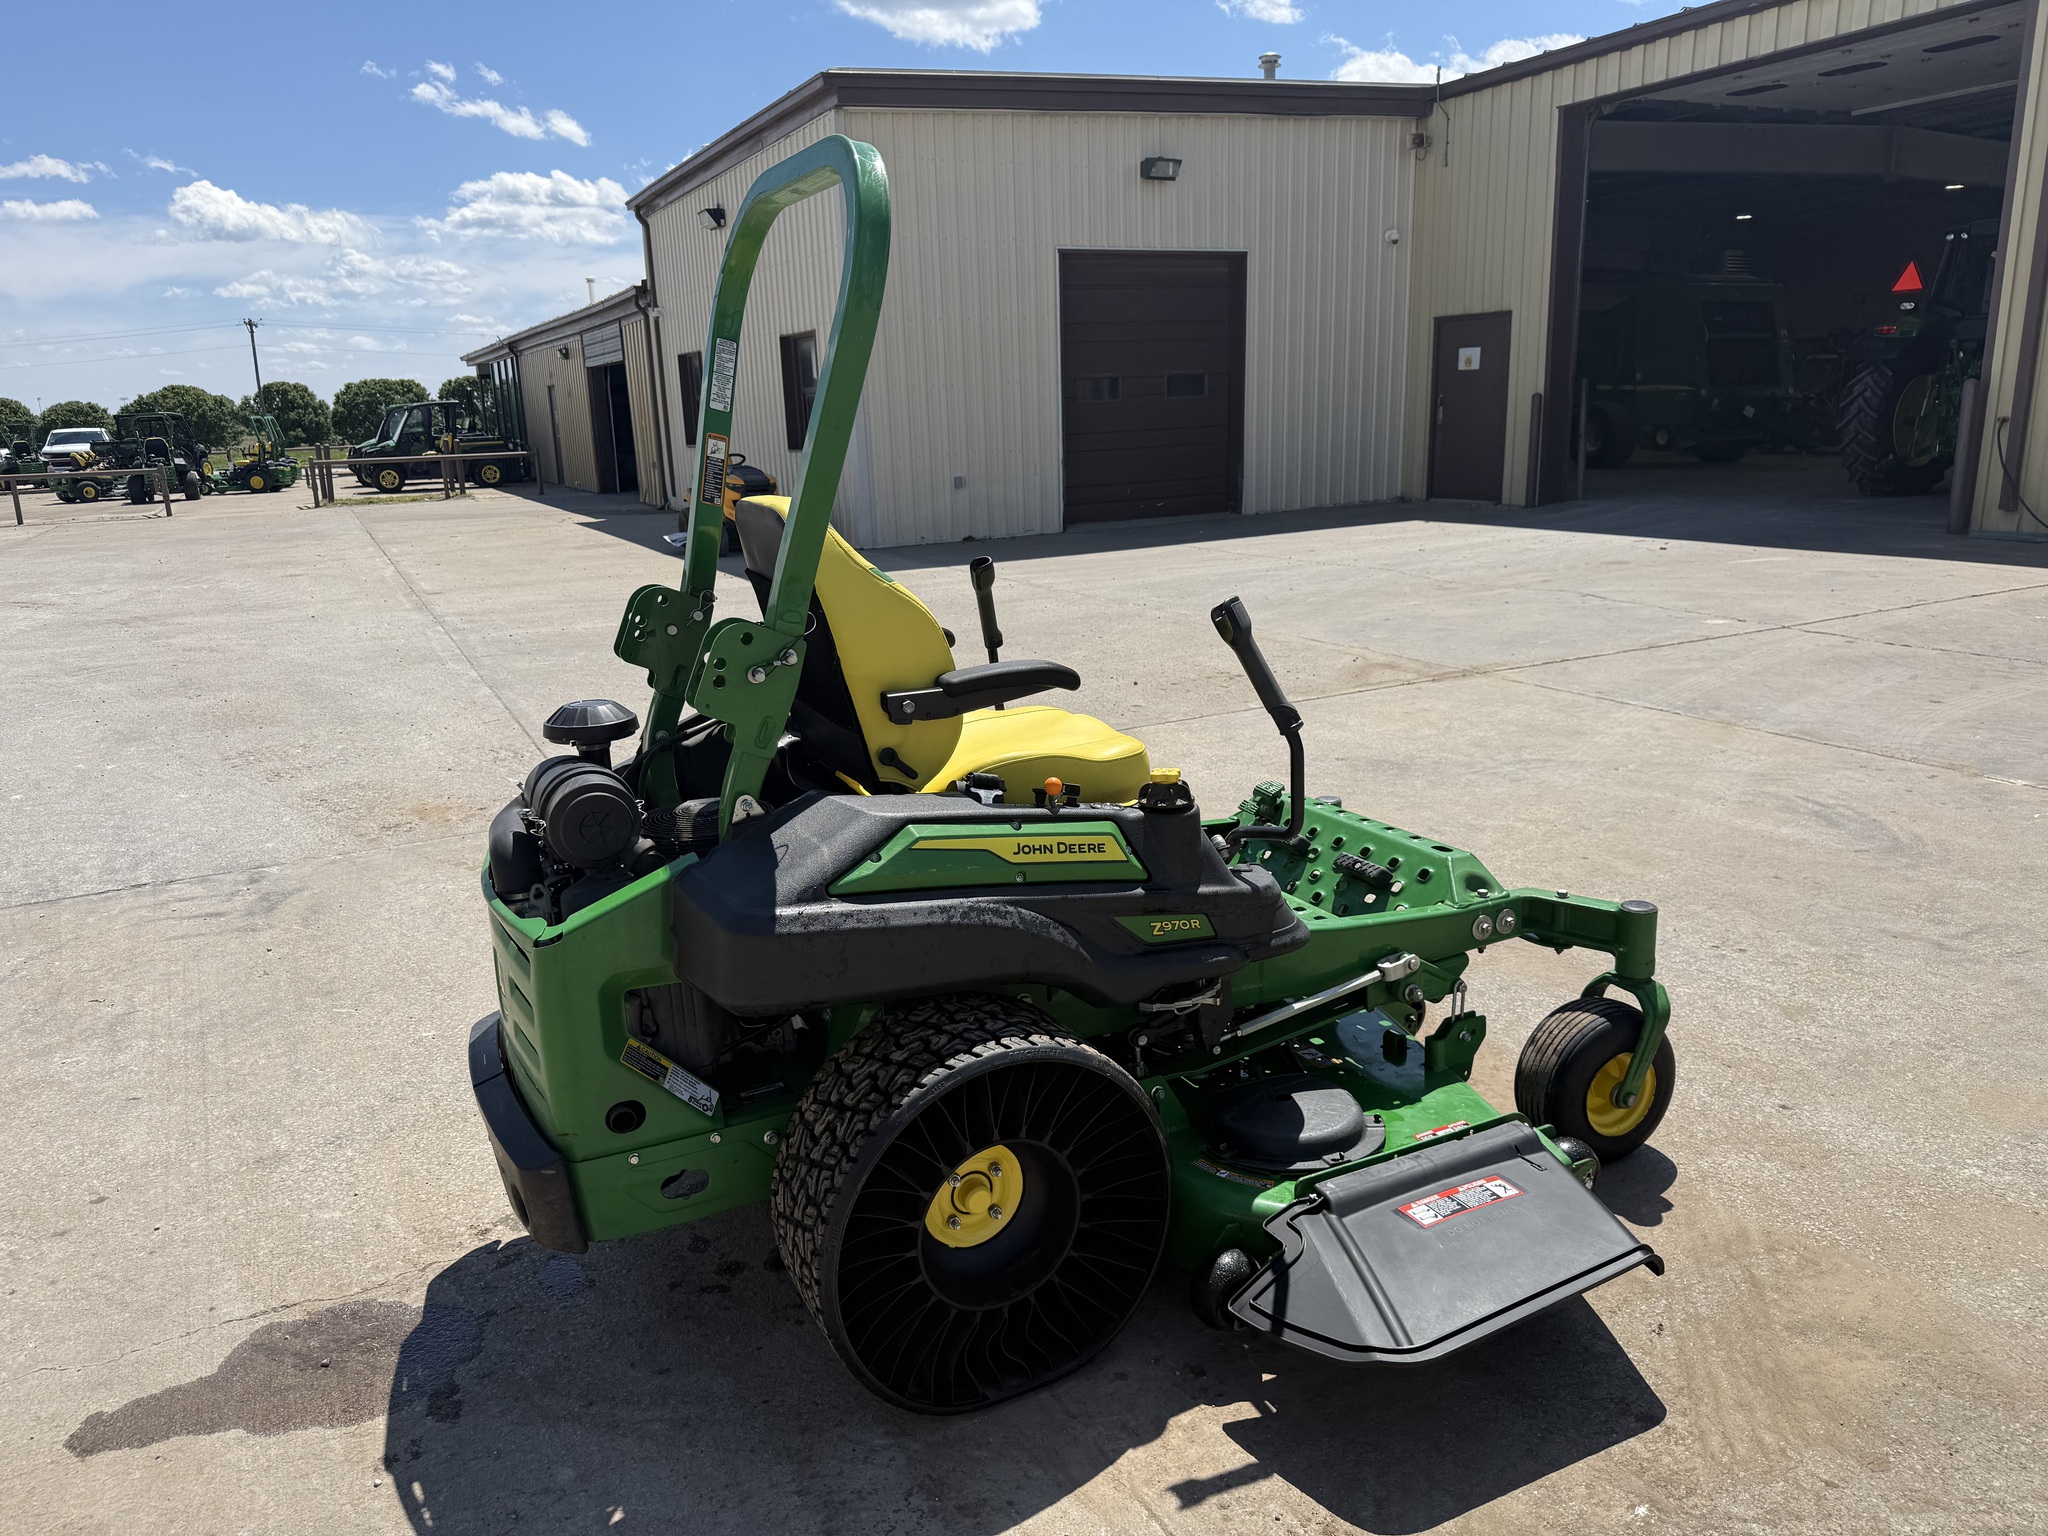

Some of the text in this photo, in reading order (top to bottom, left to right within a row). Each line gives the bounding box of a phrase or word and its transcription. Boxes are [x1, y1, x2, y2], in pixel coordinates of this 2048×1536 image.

[1013, 841, 1106, 855] JOHN DEERE
[1150, 919, 1201, 936] Z970R
[642, 1047, 662, 1062] CAUTION
